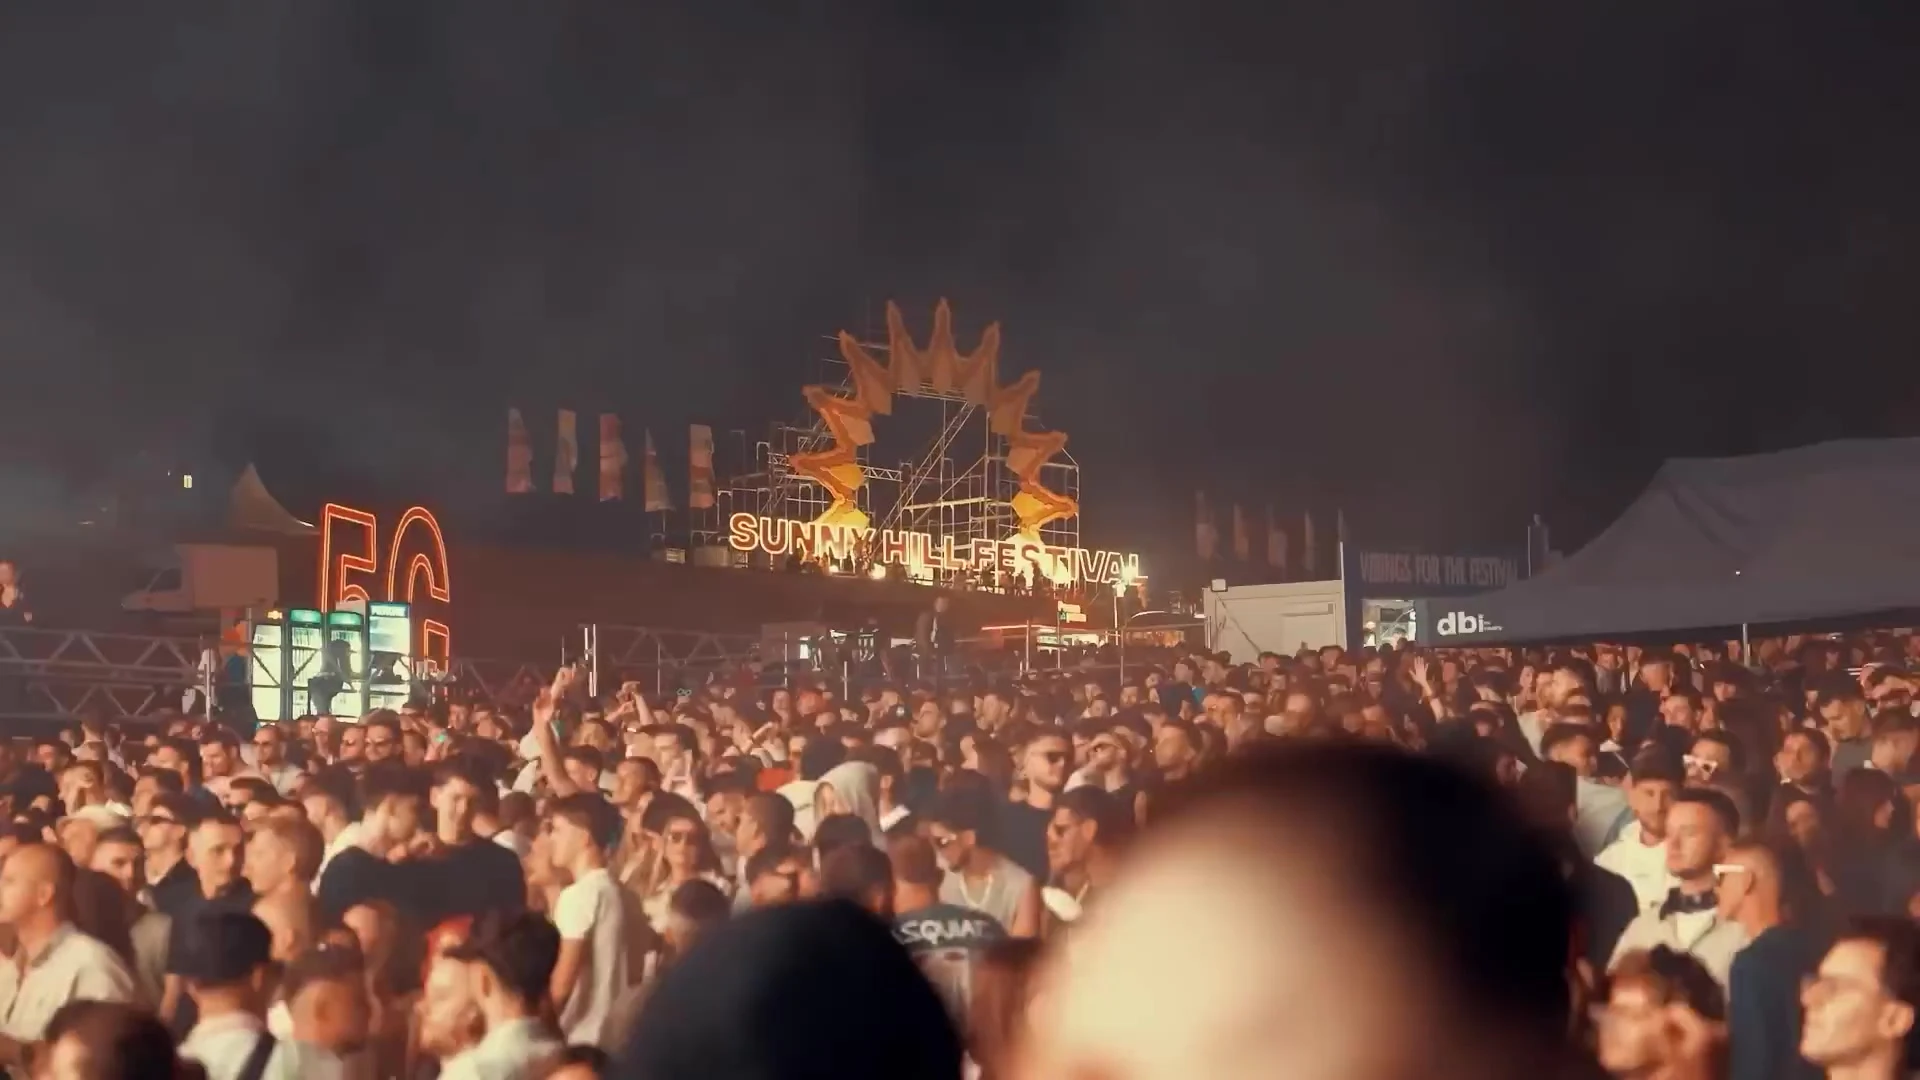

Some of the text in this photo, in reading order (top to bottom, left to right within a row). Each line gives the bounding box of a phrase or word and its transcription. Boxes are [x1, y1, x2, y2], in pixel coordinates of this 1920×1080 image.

[729, 512, 1149, 586] SUNNY HILL FESTIVAL
[1415, 554, 1440, 585] FOR
[1444, 555, 1467, 585] THE
[1437, 611, 1484, 636] dbi
